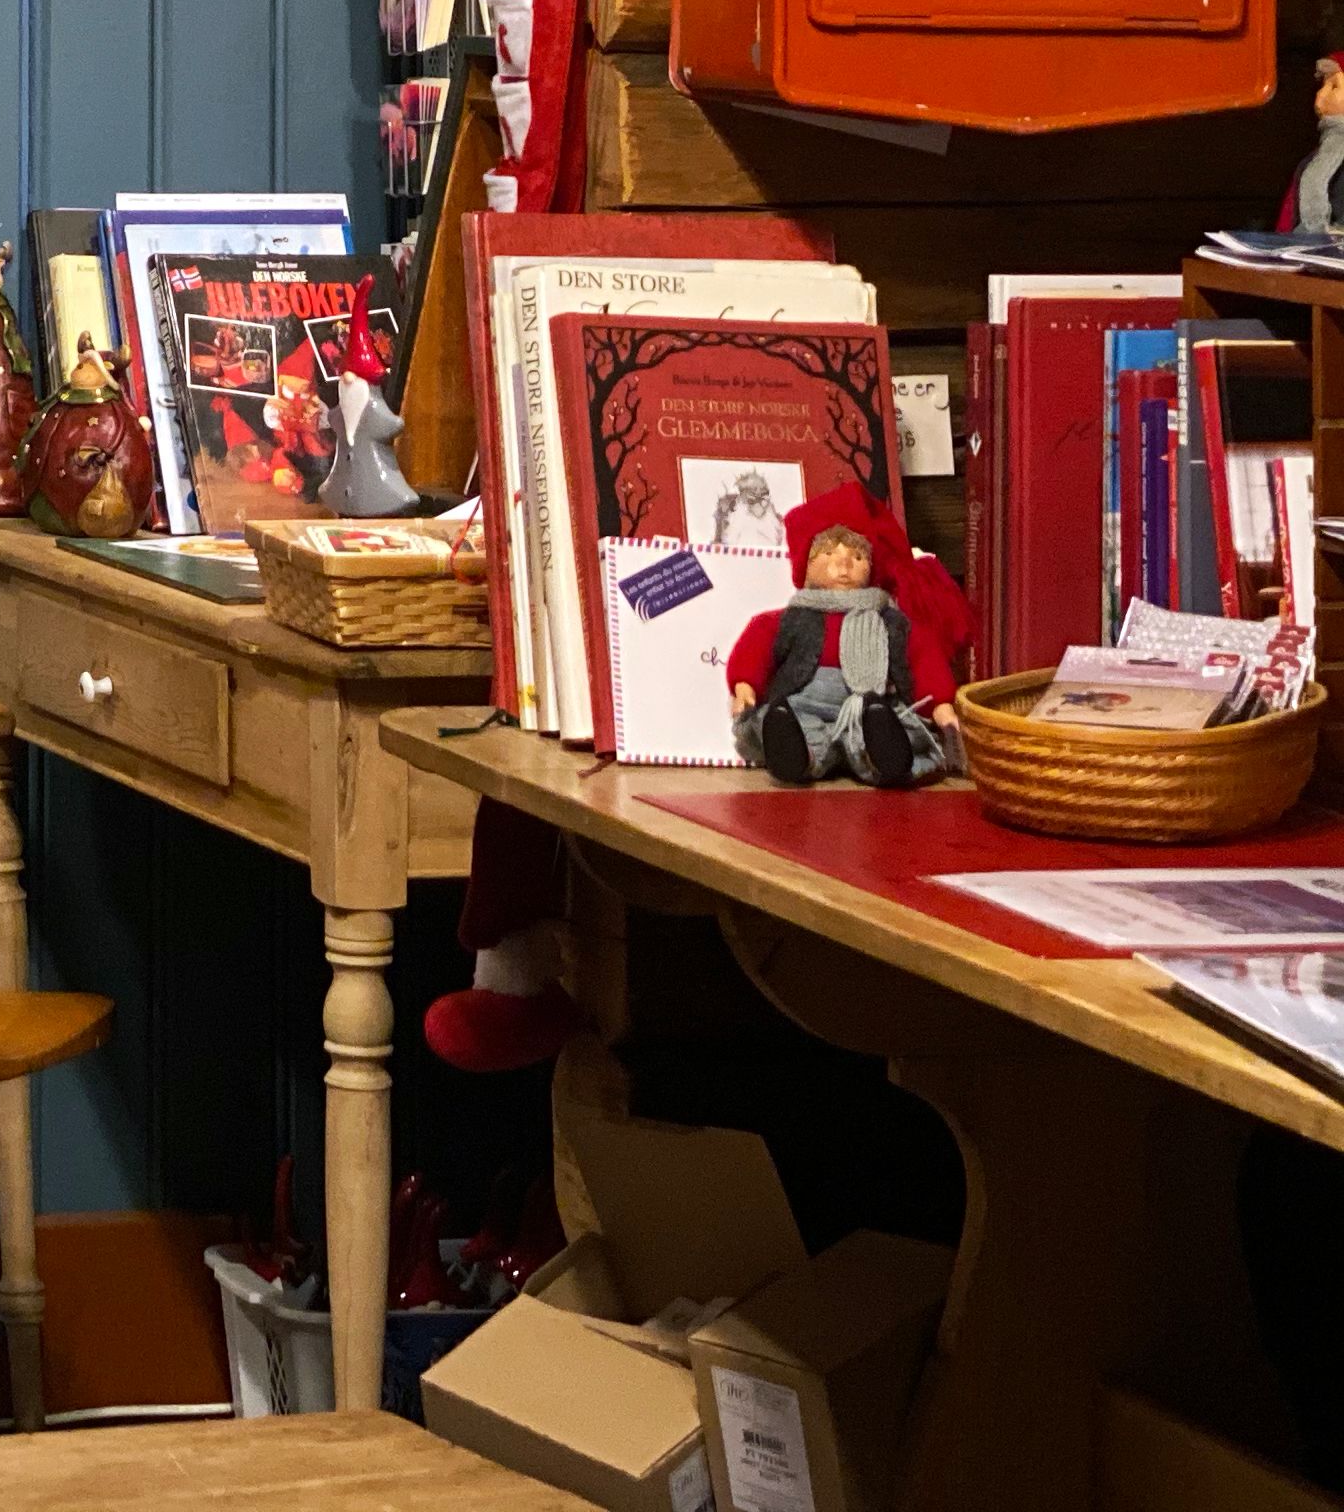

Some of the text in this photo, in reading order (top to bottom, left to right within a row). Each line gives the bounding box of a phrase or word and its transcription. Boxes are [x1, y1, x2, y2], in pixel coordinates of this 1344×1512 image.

[252, 271, 309, 283] DEN NORSKE
[558, 270, 686, 294] DEN STORE
[519, 286, 538, 332] DEN
[524, 341, 543, 417] STORE
[661, 399, 810, 417] DEN STORE NORSKE
[657, 416, 819, 443] GLEMMEBOKA
[529, 425, 555, 573] NISSEBOKEN
